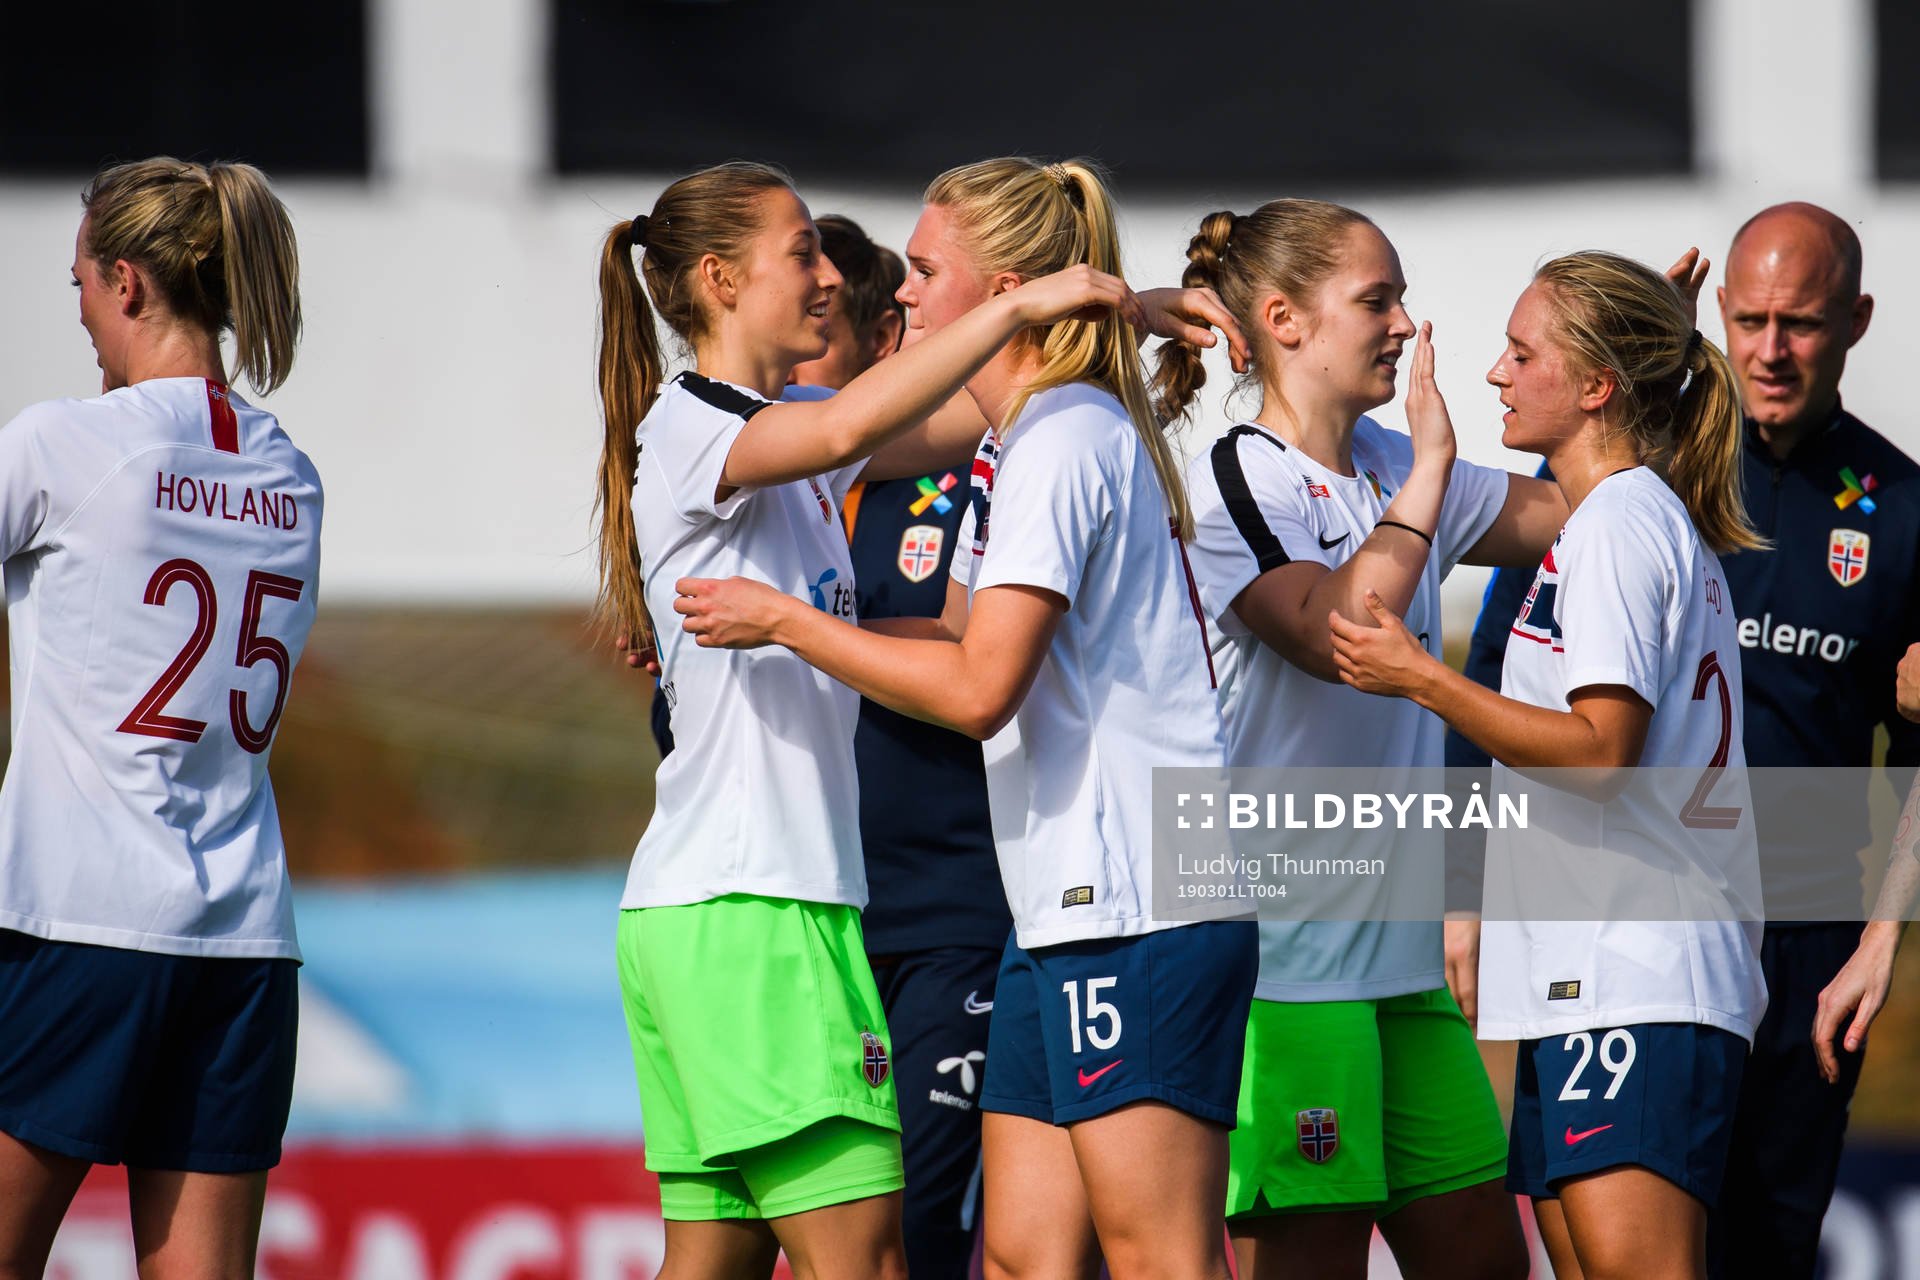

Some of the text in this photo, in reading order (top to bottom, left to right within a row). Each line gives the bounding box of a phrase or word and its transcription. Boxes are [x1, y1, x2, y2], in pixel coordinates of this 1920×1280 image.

[156, 472, 298, 531] HOVLAND
[115, 558, 304, 754] 25
[1737, 612, 1858, 662] elenor
[1062, 976, 1122, 1053] 15
[1558, 1029, 1637, 1101] 29
